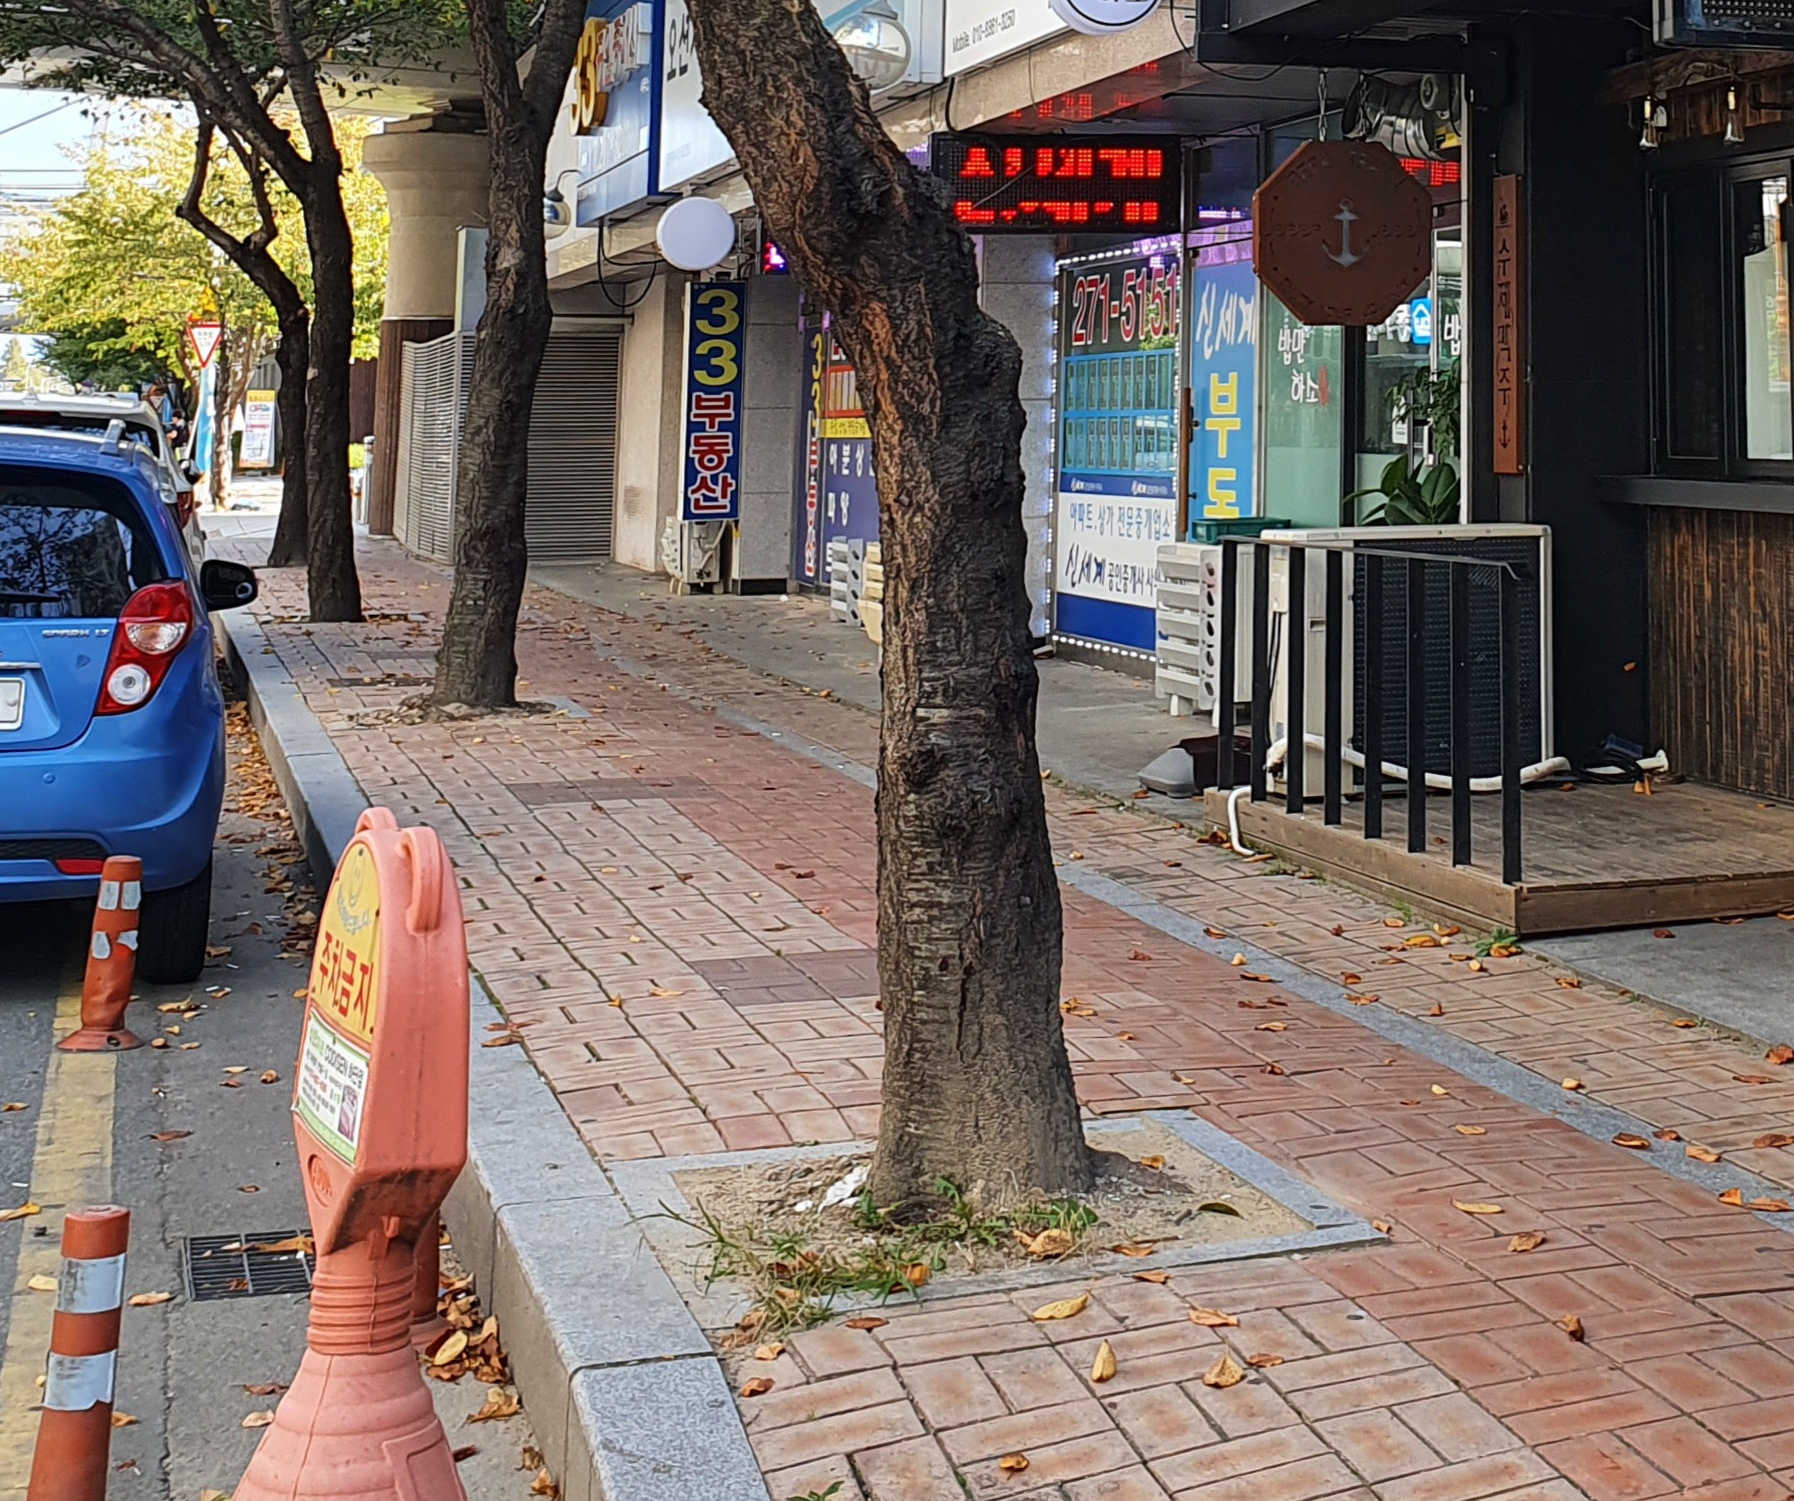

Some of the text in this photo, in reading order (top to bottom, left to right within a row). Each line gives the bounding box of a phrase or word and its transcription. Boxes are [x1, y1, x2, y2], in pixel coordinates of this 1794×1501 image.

[1072, 264, 1179, 346] 271-5151
[687, 391, 736, 515] 부동산
[319, 930, 374, 1032] 주차금지
